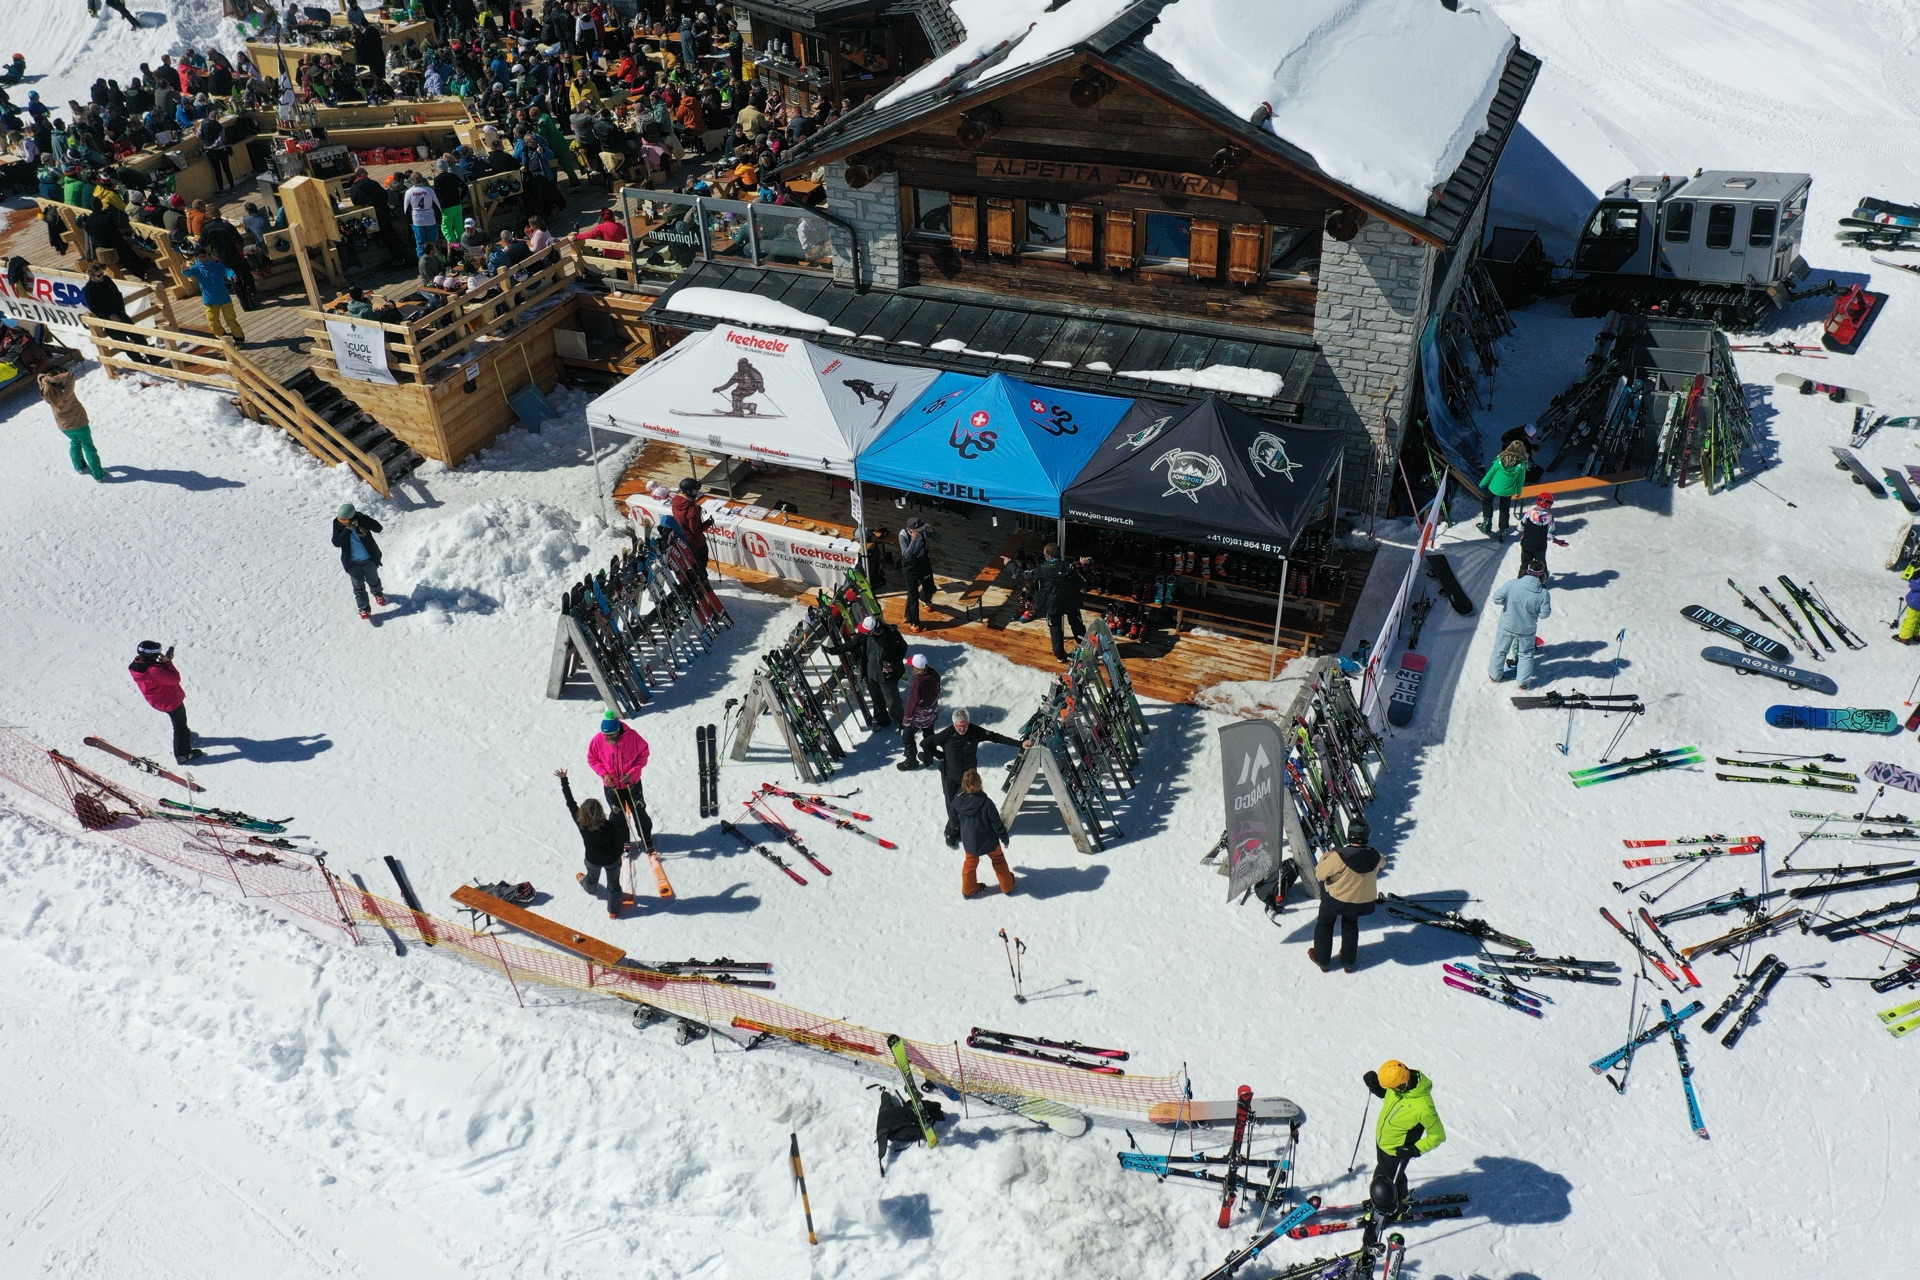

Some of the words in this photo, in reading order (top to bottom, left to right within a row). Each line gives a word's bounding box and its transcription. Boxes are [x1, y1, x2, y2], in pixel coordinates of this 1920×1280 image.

[992, 159, 1101, 181] ALPETTA
[418, 197, 425, 209] 4
[726, 330, 789, 353] freeheeler
[643, 422, 680, 436] freeheeler
[750, 444, 789, 458] freeheeler
[937, 481, 990, 503] FJELL
[1068, 509, 1134, 526] www.jon-sport.ch
[790, 543, 857, 565] freeheeler
[1261, 543, 1271, 552] 18
[1272, 546, 1282, 554] 17
[776, 553, 814, 566] TELEMARK
[815, 561, 851, 571] COMMUNI
[1691, 608, 1725, 627] GNU
[1743, 632, 1778, 653] GNU
[1741, 657, 1796, 677] BURTON
